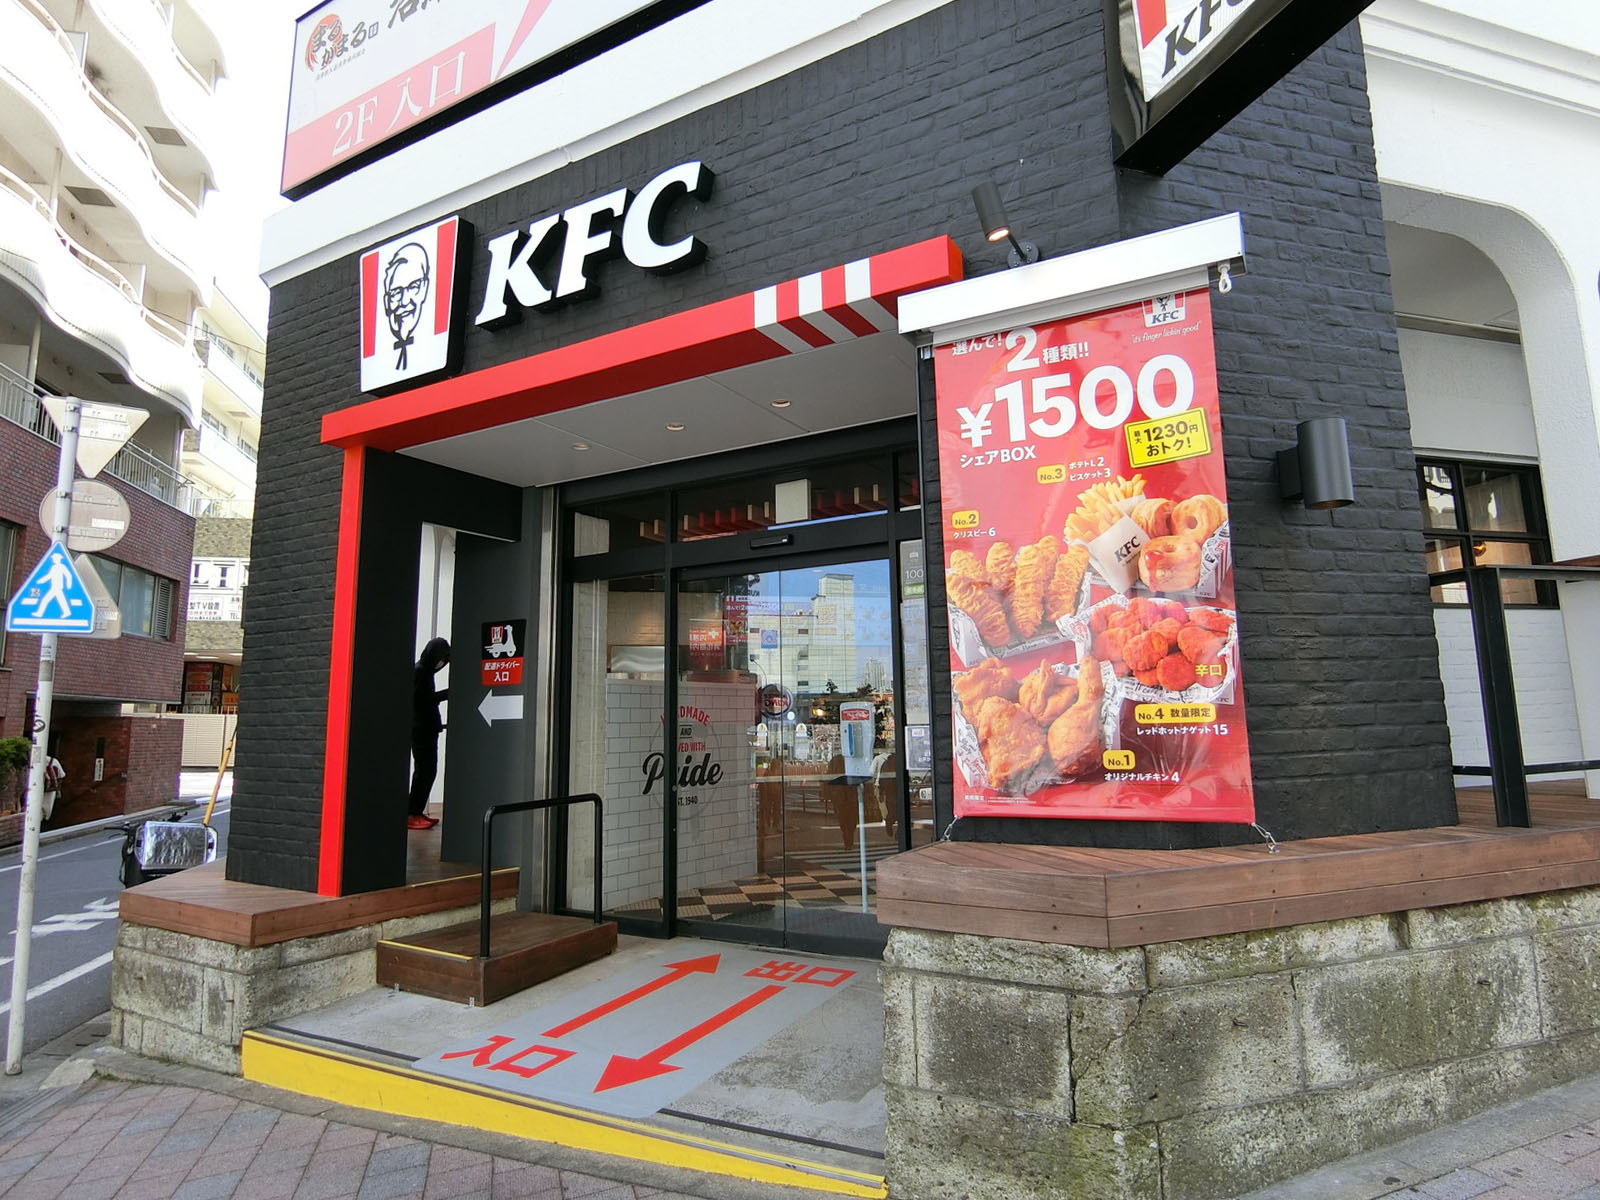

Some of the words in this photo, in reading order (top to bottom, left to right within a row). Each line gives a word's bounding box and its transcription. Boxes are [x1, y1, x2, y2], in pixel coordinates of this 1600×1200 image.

[1161, 0, 1247, 78] KF
[332, 99, 378, 156] 2F
[385, 50, 467, 132] 入口
[474, 161, 701, 326] KFC
[1151, 310, 1179, 324] KFC
[956, 354, 1195, 448] ¥1500
[1146, 437, 1192, 457] おトク!
[960, 445, 1037, 469] シェアBOX
[1040, 468, 1063, 481] No.3
[1104, 467, 1111, 478] 3
[954, 513, 977, 526] No.2
[988, 527, 996, 537] 6
[1114, 536, 1141, 562] KFC
[494, 671, 510, 682] 入口
[1195, 663, 1223, 677] 辛口
[1138, 708, 1165, 720] No.4
[1170, 707, 1211, 718] 数量限定
[680, 727, 693, 737] AND
[1213, 723, 1229, 736] 15
[690, 741, 706, 752] WITH
[1107, 754, 1130, 766] No.1
[642, 752, 724, 795] Pide
[1171, 771, 1180, 783] 4
[743, 960, 858, 987] 出口
[441, 1035, 577, 1078] 入口
